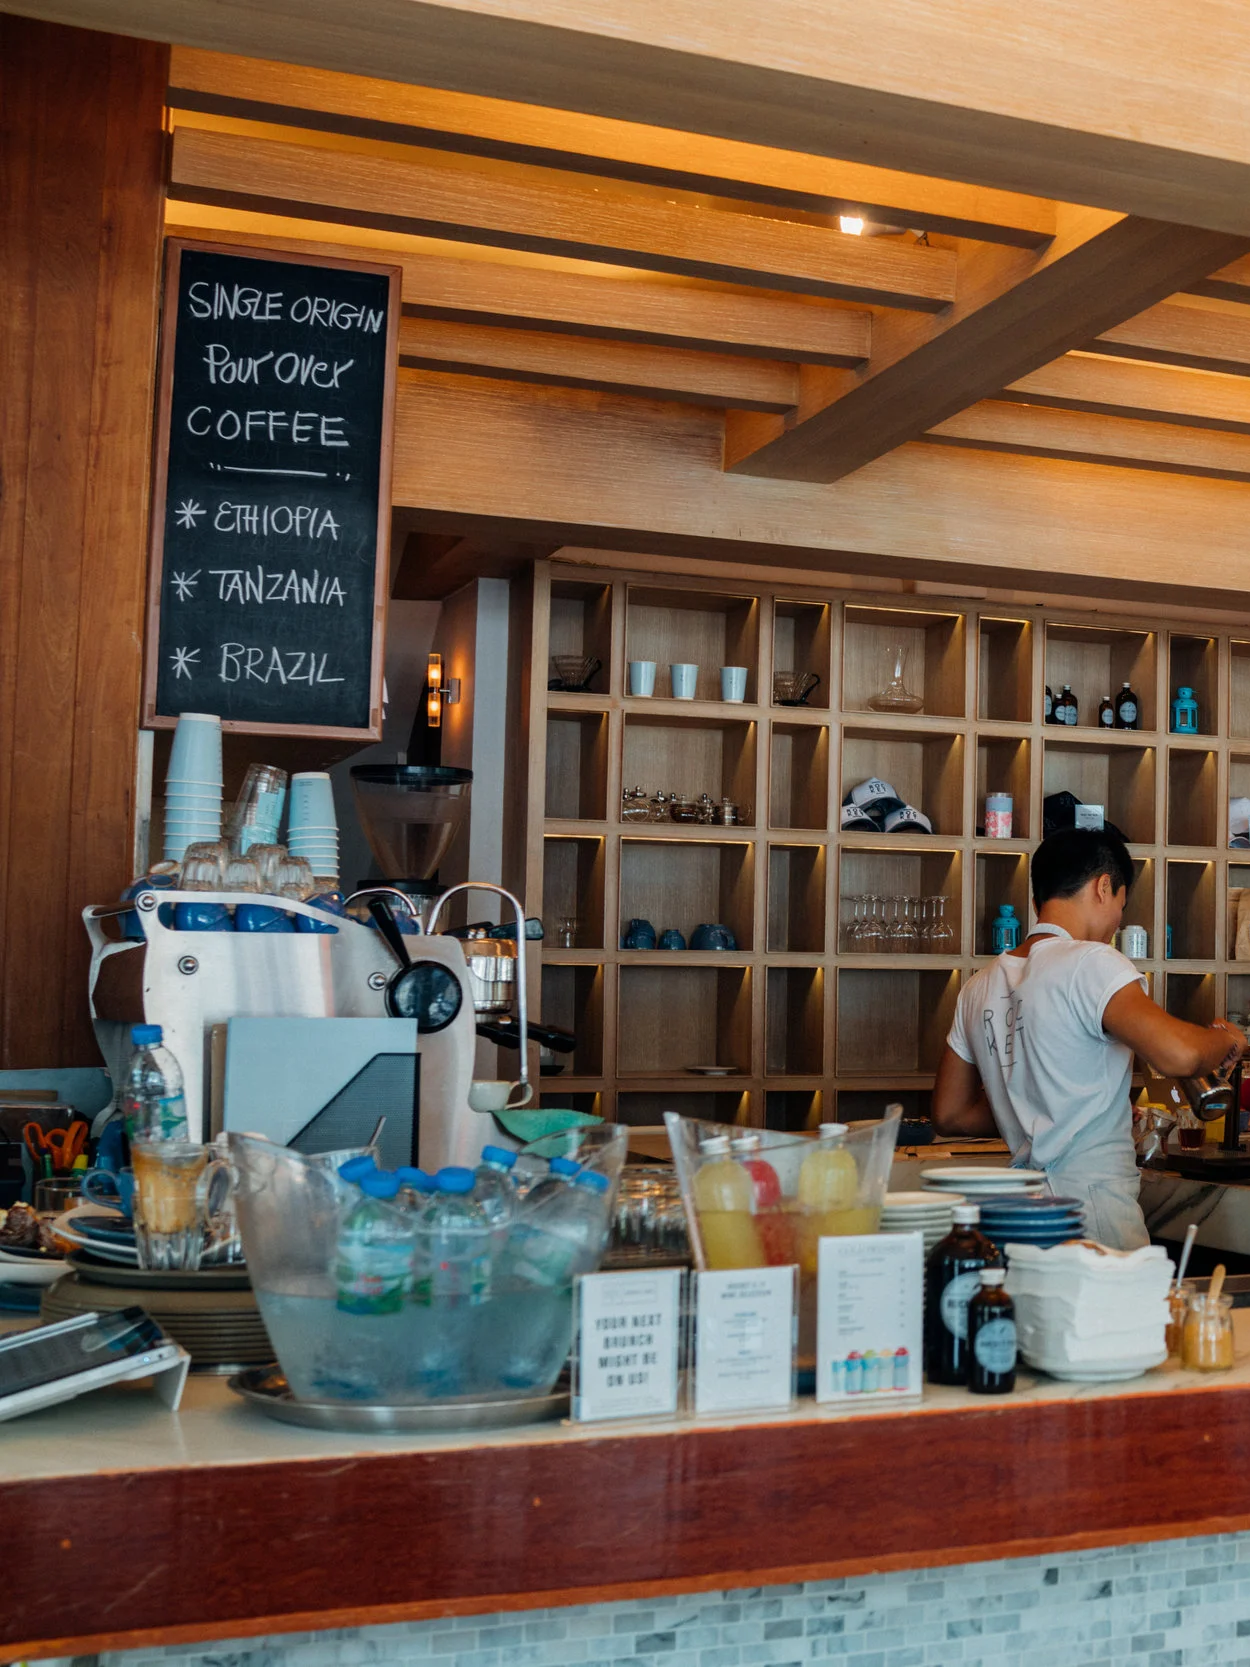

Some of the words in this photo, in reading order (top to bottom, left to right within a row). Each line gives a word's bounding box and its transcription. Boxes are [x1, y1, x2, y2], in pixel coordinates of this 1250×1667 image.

[188, 282, 283, 320] SINGLE
[290, 297, 384, 333] ORIGIN
[187, 406, 350, 447] COFFEE
[213, 501, 341, 540] ETHIOPIA
[209, 565, 348, 606] TANZANIA
[219, 642, 345, 686] BRAZIL
[595, 1316, 628, 1331] YOUR
[632, 1313, 663, 1328] NEXT
[598, 1353, 638, 1369] MIGHT
[642, 1351, 658, 1366] BE
[603, 1334, 654, 1350] BRUNCH
[606, 1374, 624, 1388] ON
